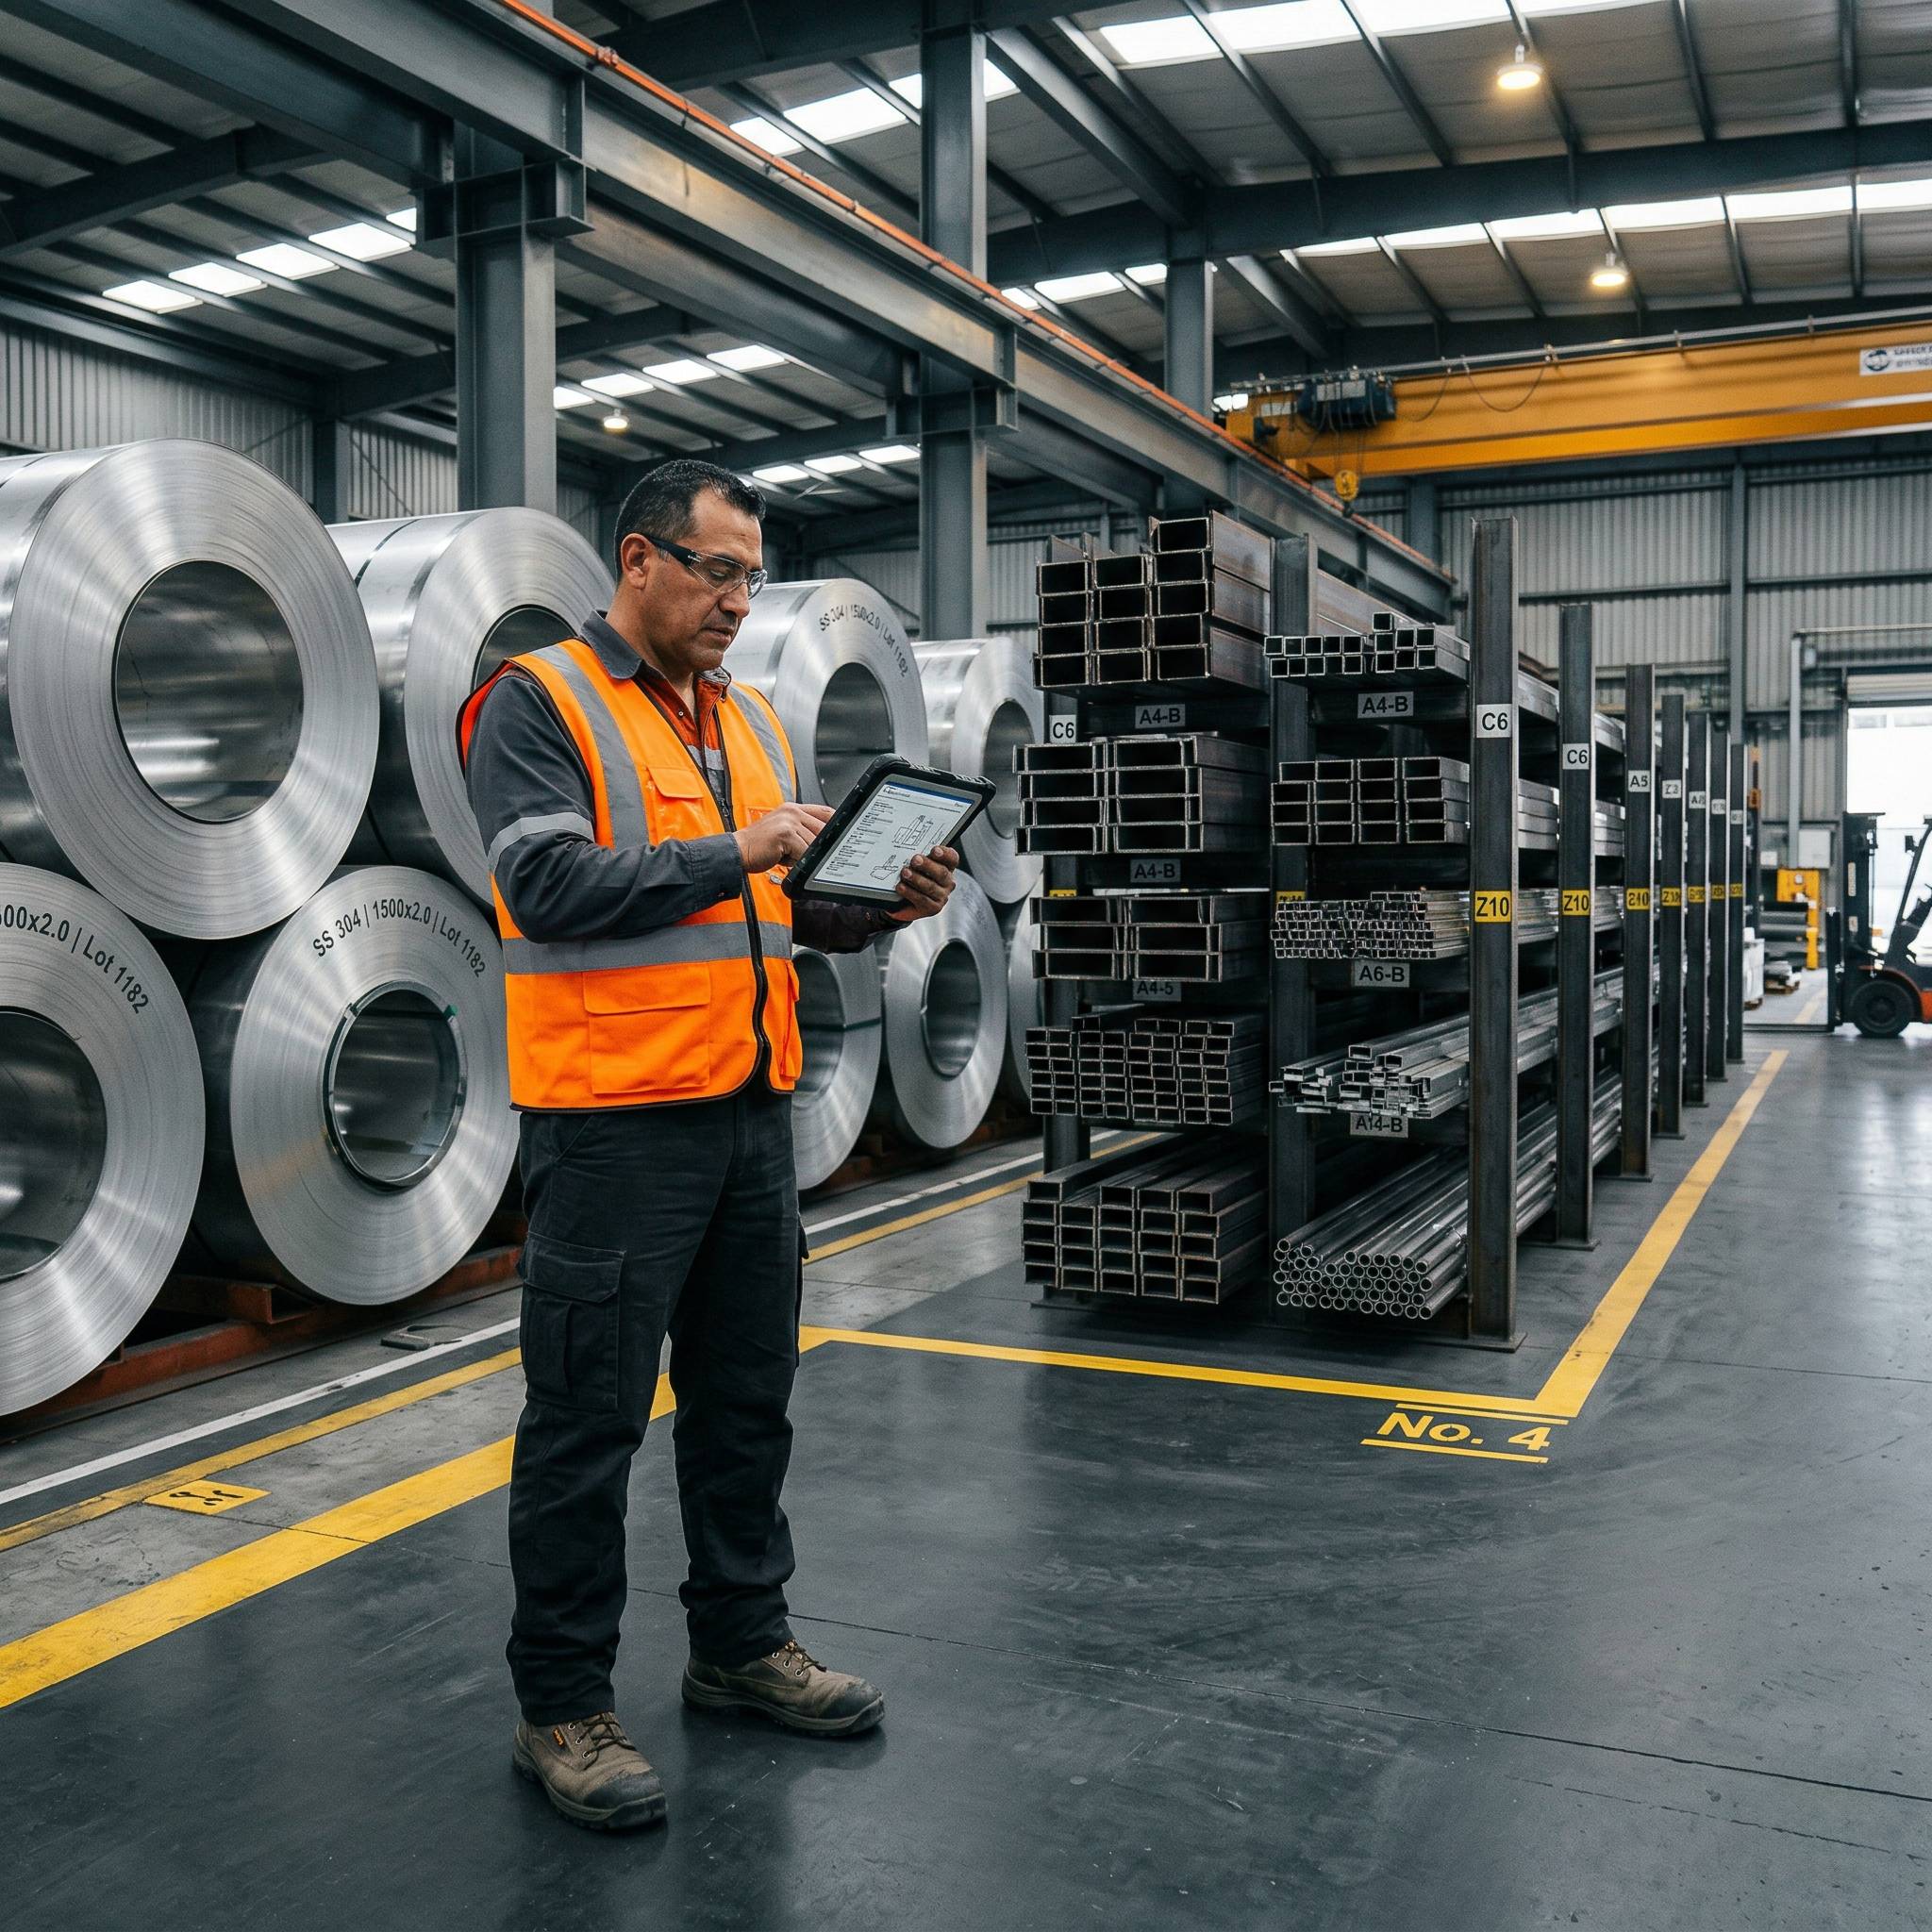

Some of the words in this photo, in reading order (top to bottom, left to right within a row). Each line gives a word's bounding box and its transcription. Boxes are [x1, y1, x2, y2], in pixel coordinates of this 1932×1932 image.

[1361, 695, 1408, 714] A4-B
[1139, 708, 1181, 724] A4-B
[1481, 712, 1508, 731] C6
[1052, 722, 1075, 739] C6
[1566, 749, 1589, 764] C6
[1629, 775, 1648, 787] A5
[1134, 863, 1176, 878] A4-B
[1475, 896, 1509, 917] Z10
[1563, 894, 1590, 911] Z10
[313, 930, 334, 957] SS
[335, 908, 361, 939] 304
[373, 898, 431, 924] 1500x2.0
[440, 916, 461, 946] Lot
[460, 939, 486, 977] 1182
[82, 935, 115, 974] Lot
[114, 967, 149, 1014] 1182
[1358, 965, 1406, 983] A6-B
[1376, 1412, 1484, 1445] No.
[1507, 1426, 1552, 1451] 4
